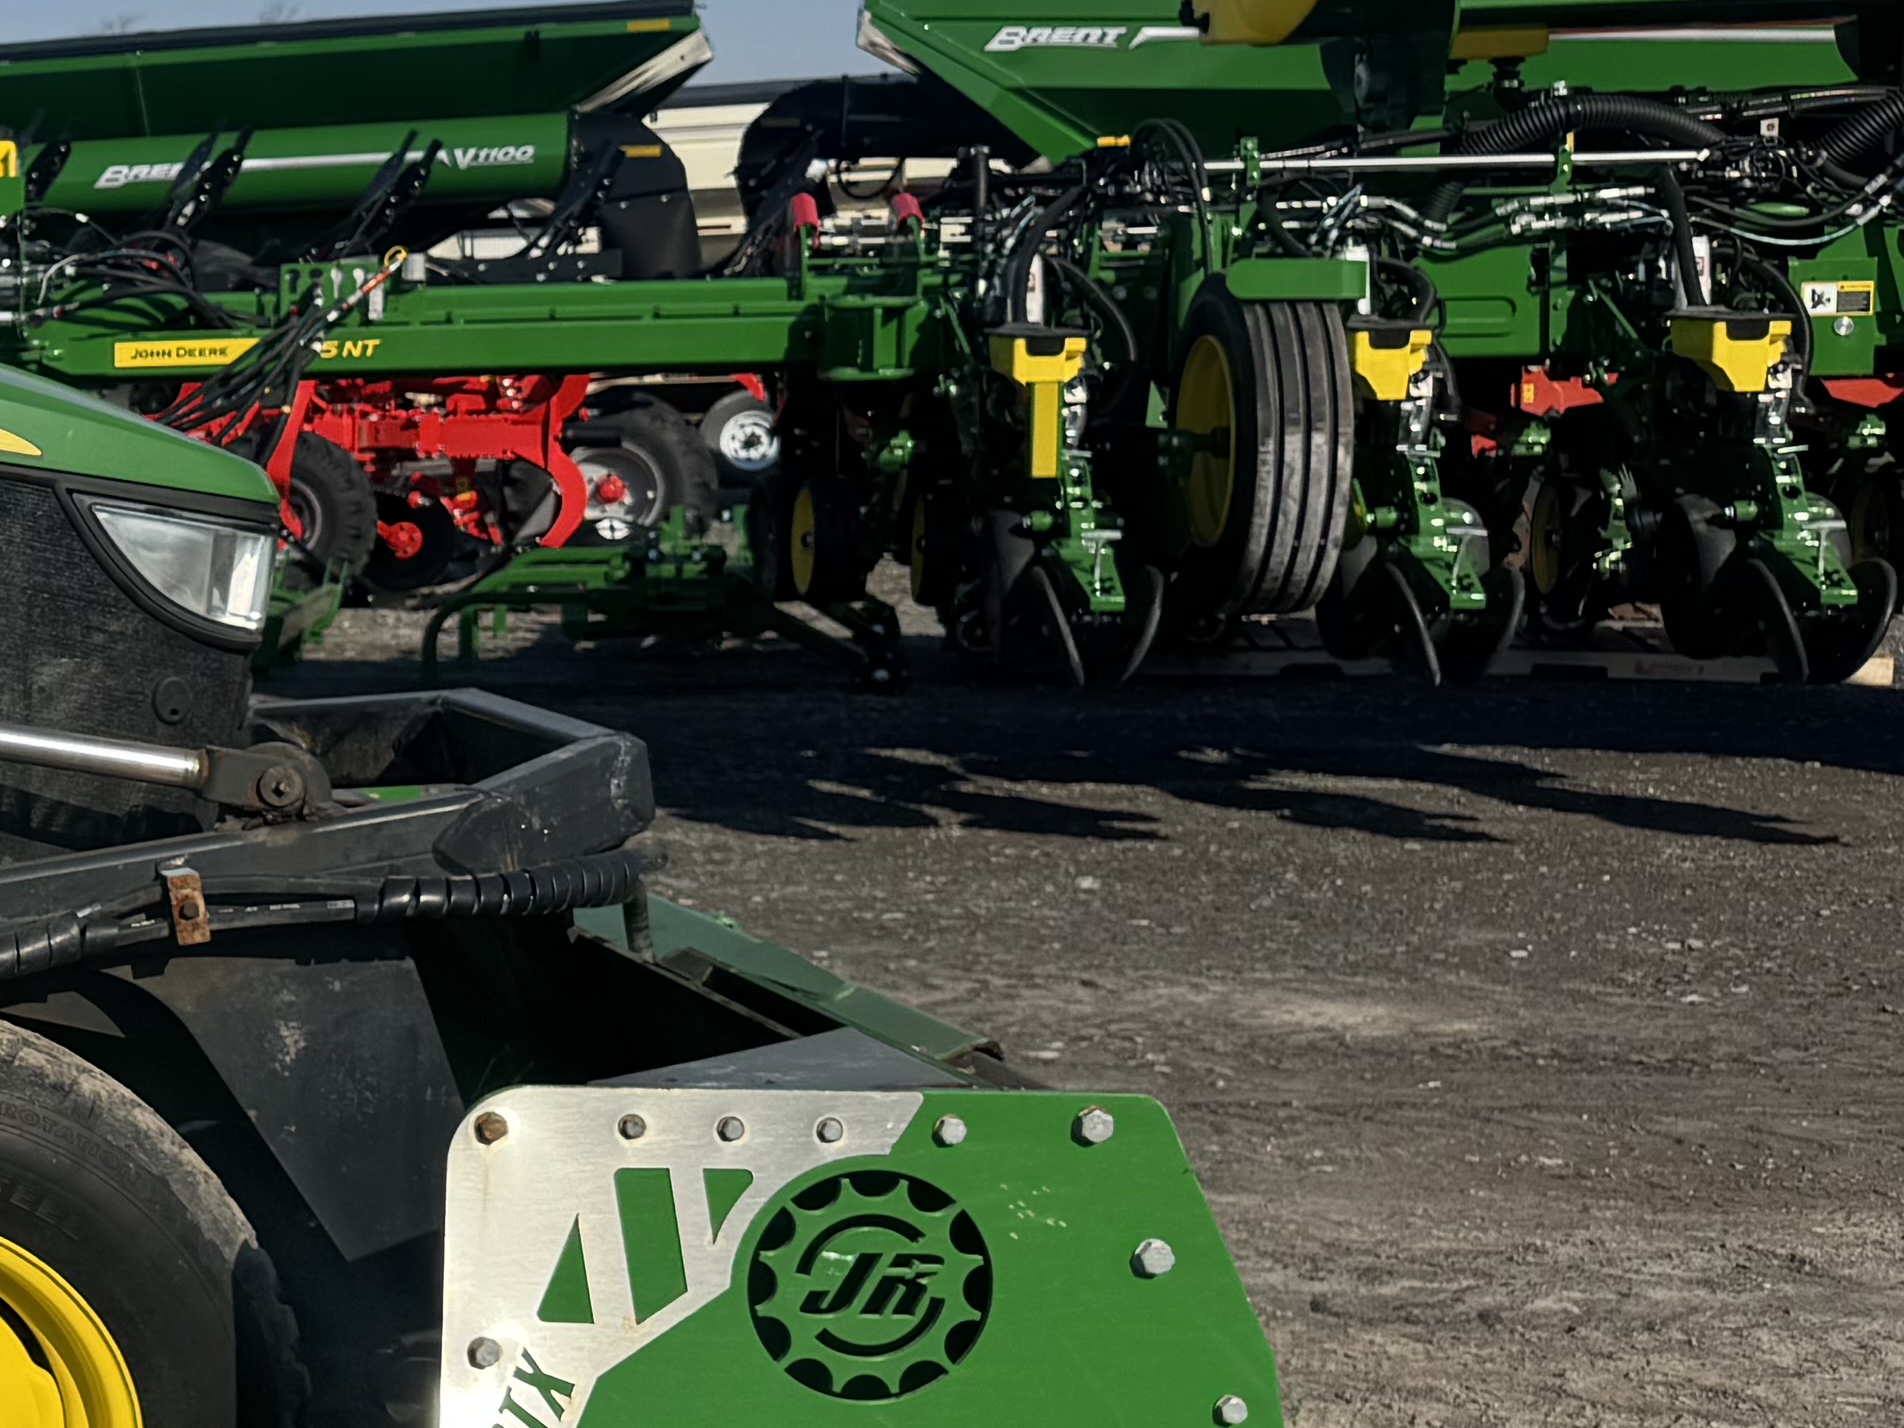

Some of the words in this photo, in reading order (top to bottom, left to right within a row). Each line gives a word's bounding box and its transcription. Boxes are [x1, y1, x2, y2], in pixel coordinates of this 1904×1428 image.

[93, 162, 185, 189] BRE
[453, 145, 535, 170] V1100
[130, 347, 173, 360] JOHN
[176, 346, 229, 358] DEERE
[342, 339, 382, 358] NT
[799, 1252, 945, 1316] JR
